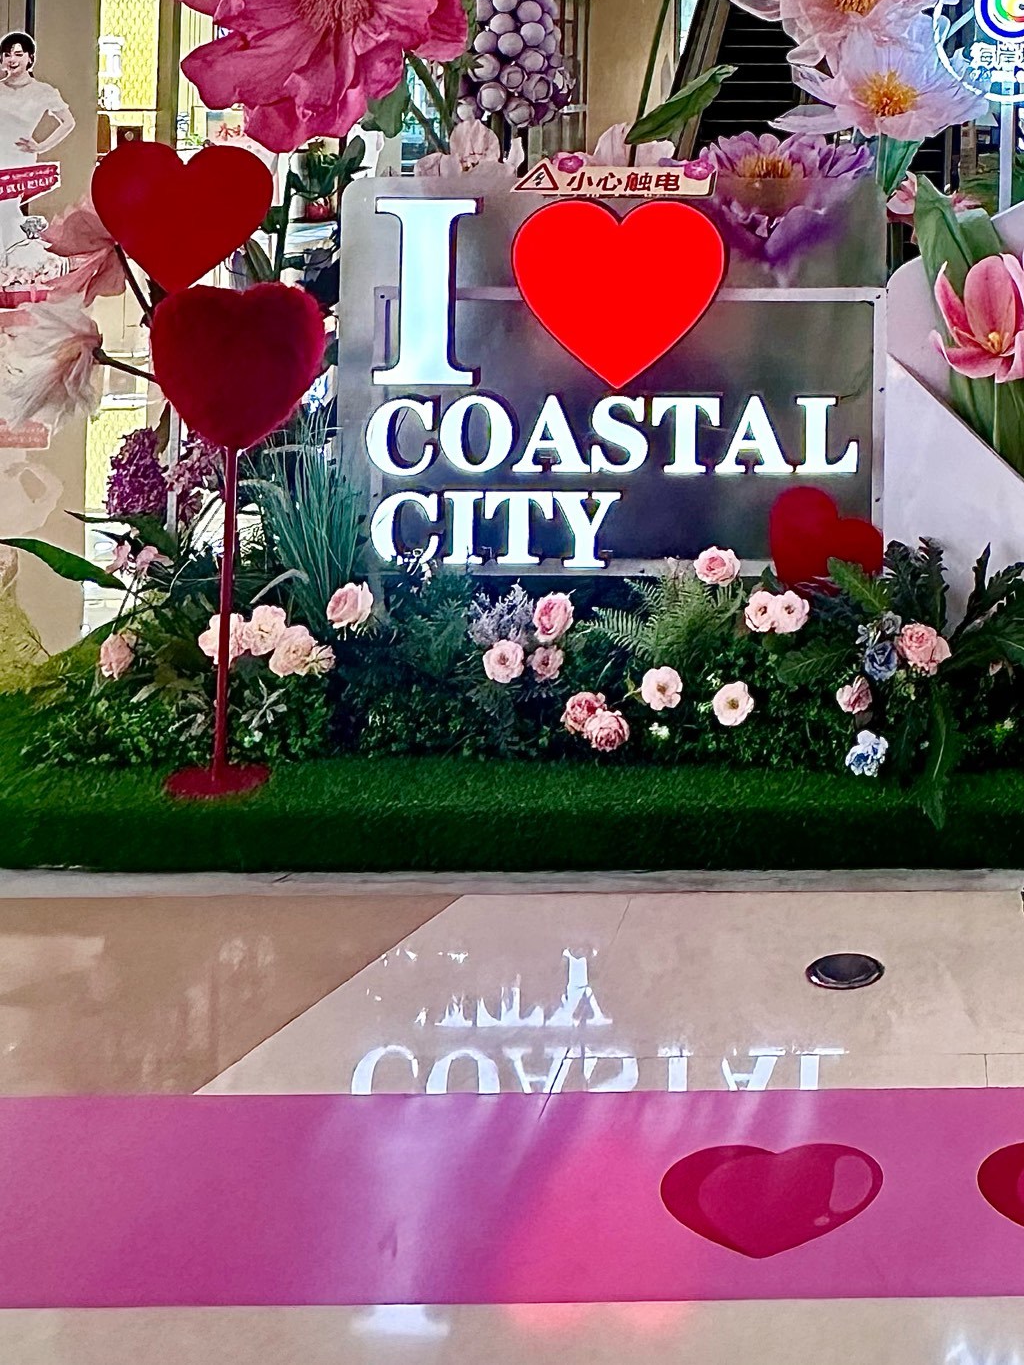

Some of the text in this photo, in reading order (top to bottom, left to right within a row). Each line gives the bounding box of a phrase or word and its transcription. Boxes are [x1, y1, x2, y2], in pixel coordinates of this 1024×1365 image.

[566, 171, 681, 192] 小心触电
[372, 198, 477, 386] I
[365, 394, 860, 476] COASTAL
[370, 490, 622, 570] CITY
